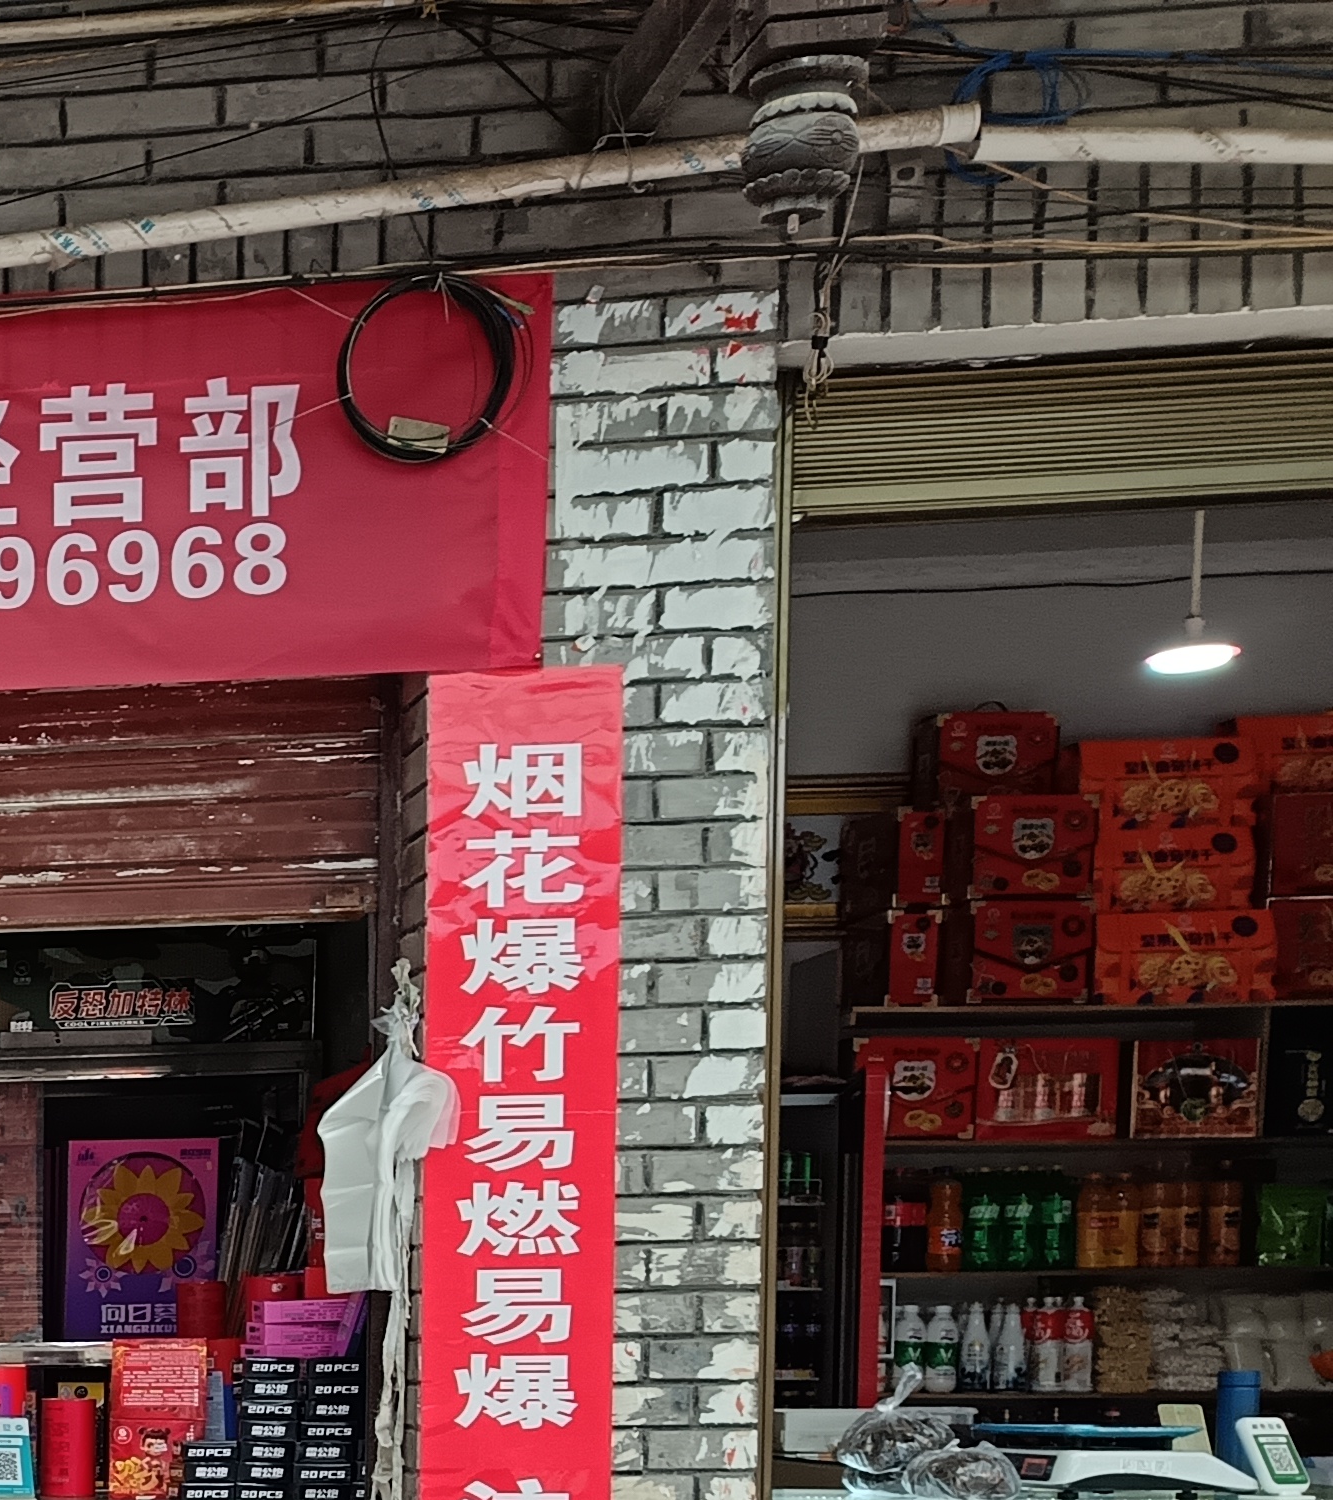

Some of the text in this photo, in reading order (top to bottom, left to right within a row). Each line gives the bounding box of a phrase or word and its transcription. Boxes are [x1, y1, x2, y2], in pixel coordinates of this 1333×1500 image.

[50, 987, 195, 1019] 反恐加特林
